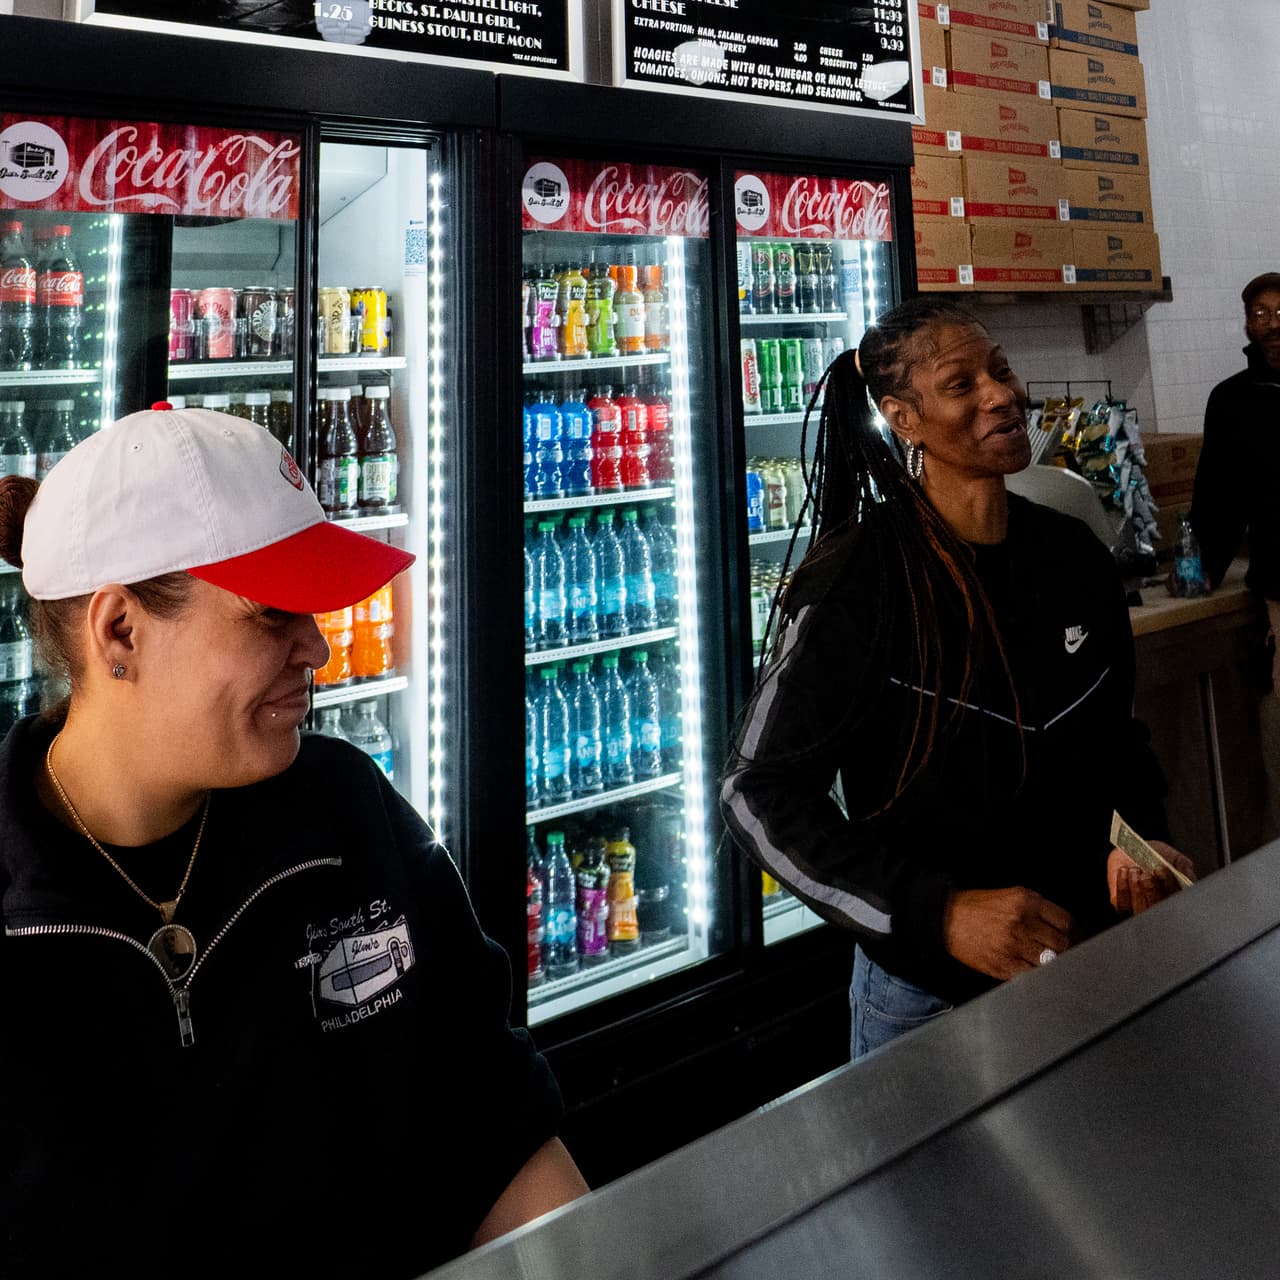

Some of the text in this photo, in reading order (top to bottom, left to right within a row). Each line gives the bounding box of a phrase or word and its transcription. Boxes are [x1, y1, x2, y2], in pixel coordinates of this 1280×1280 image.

[312, 2, 353, 22] 1.25
[500, 0, 542, 18] LIGHT,
[872, 7, 902, 22] 11.99
[880, 36, 904, 52] 9.99
[634, 61, 864, 102] TOMATOES, ONIONS, HOT PEPPERS, AND SEASONING.
[79, 126, 301, 213] Coca-Cola
[584, 166, 709, 235] Coca-Cola
[782, 177, 889, 236] Coca-Cola
[329, 899, 391, 935] South St.
[321, 988, 403, 1032] PHILADELPHIA
